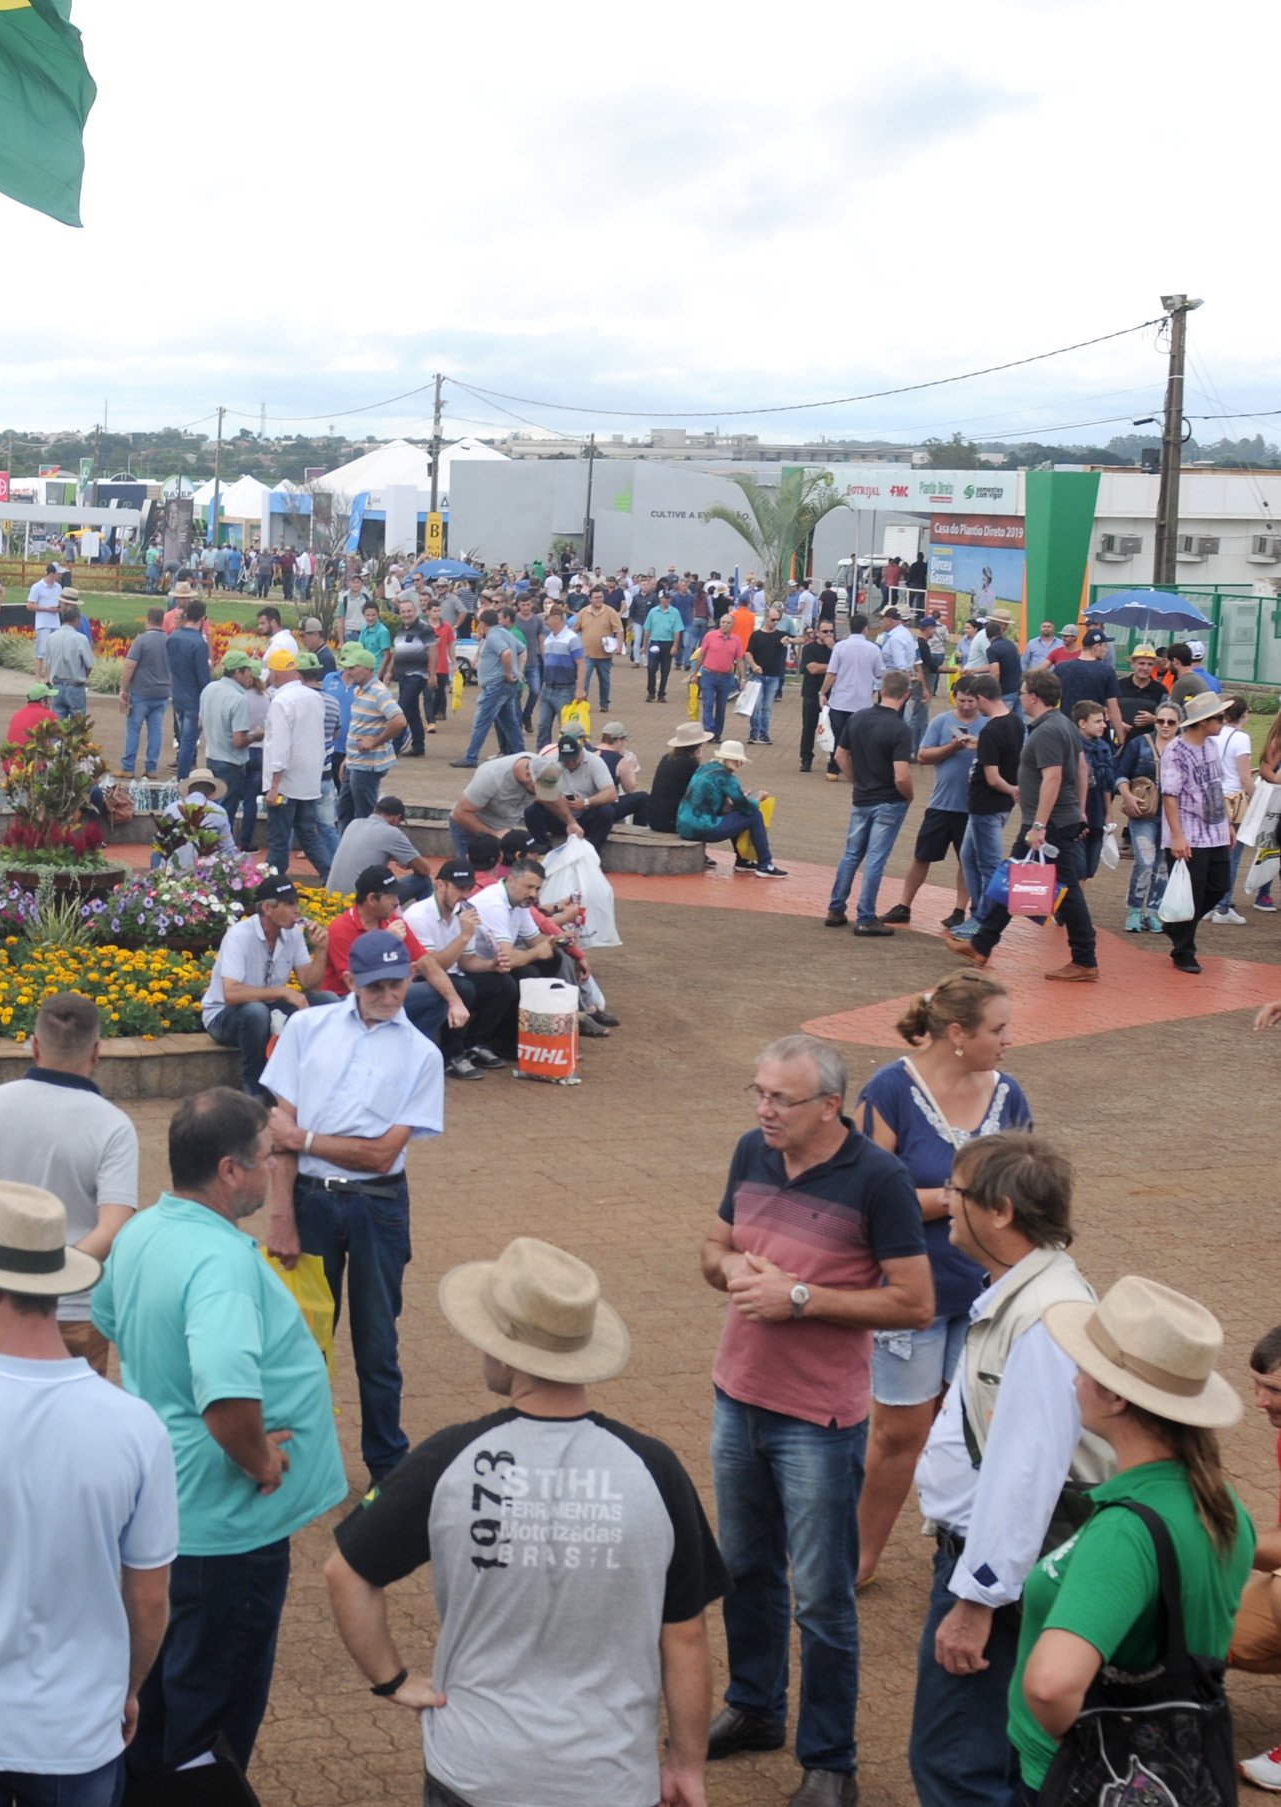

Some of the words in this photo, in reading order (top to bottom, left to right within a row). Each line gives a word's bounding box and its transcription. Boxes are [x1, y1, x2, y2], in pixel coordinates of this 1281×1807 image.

[890, 485, 909, 498] FMC
[650, 510, 686, 519] CULTIVE
[688, 511, 695, 519] A
[430, 524, 440, 538] B
[934, 522, 950, 535] Casa
[950, 523, 960, 535] do
[960, 524, 983, 536] Plantio
[984, 525, 1006, 538] Direto
[1006, 527, 1024, 539] 2019
[931, 556, 952, 571] Dirceu
[931, 570, 954, 585] Gassen
[383, 951, 399, 962] LS
[501, 1465, 624, 1500] STIHL
[500, 1500, 624, 1522] FERRMENTAS
[498, 1519, 624, 1544] Motoizadas
